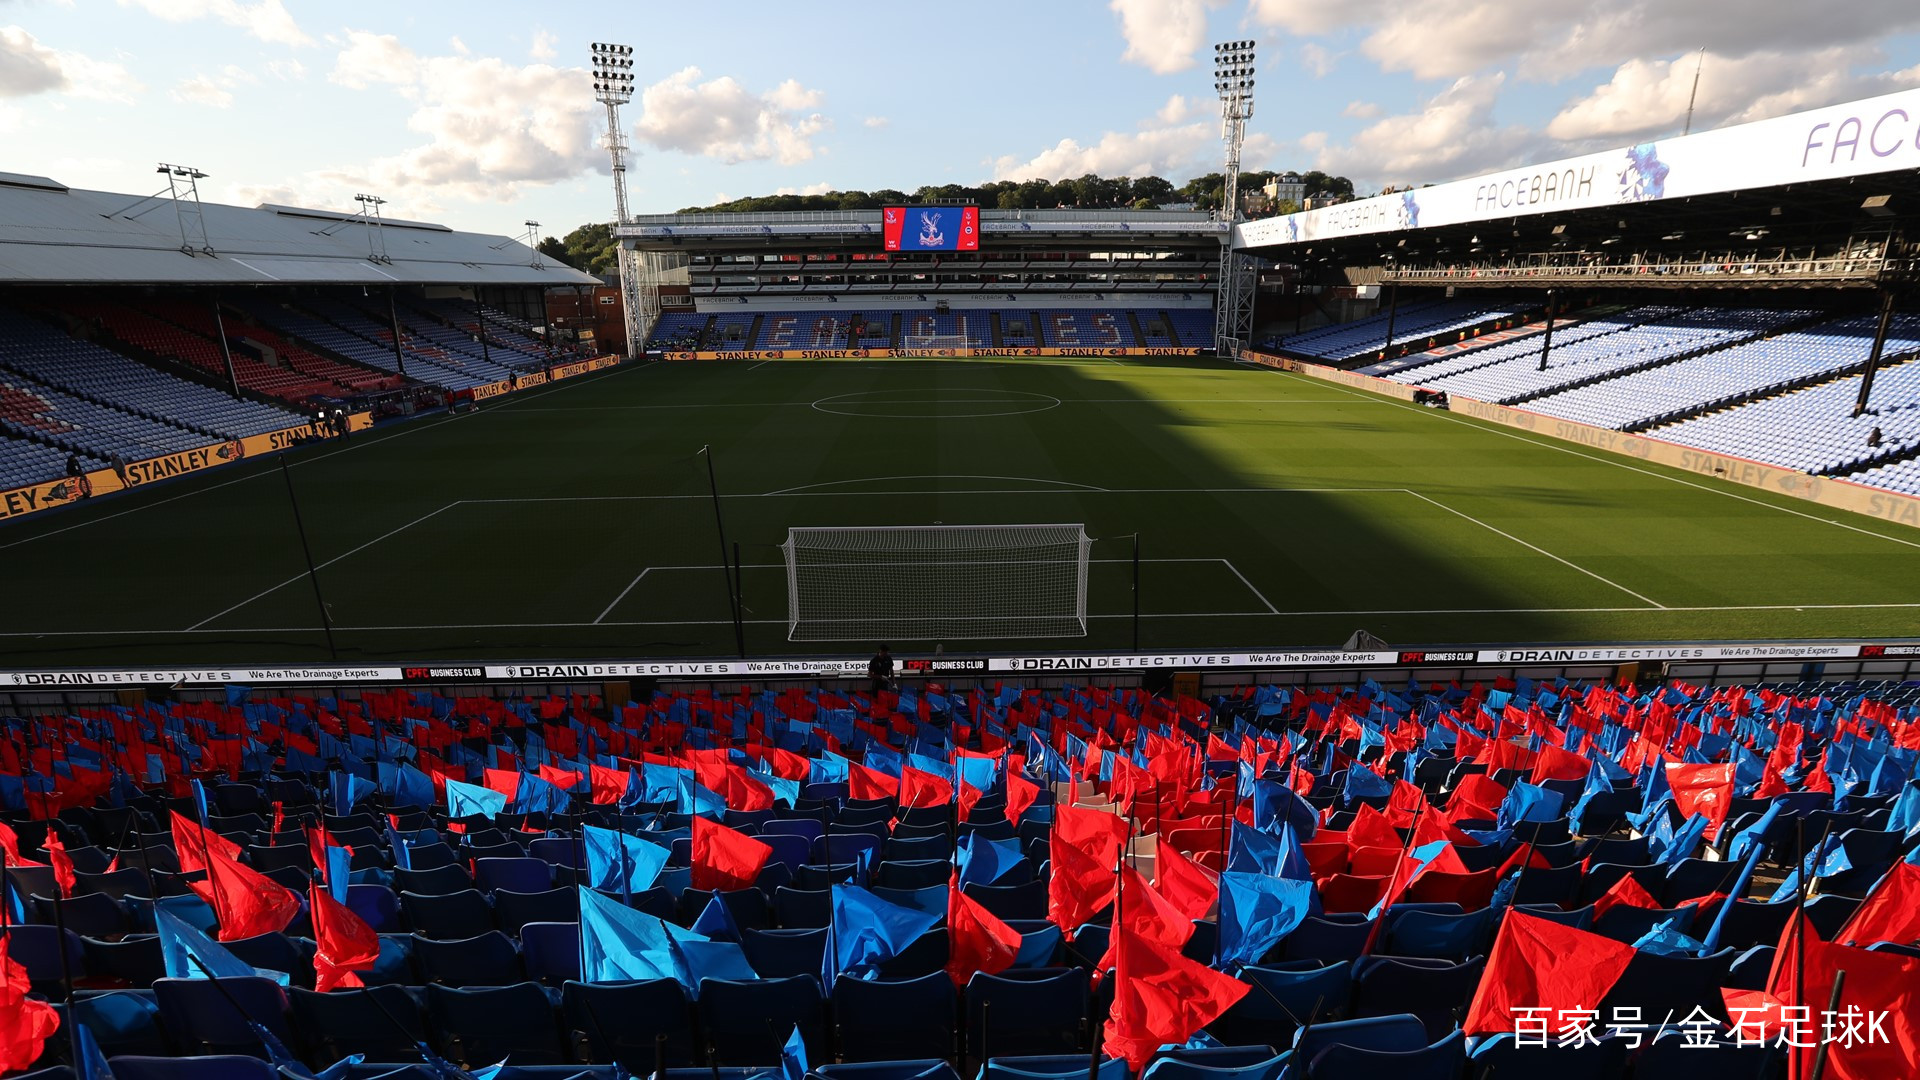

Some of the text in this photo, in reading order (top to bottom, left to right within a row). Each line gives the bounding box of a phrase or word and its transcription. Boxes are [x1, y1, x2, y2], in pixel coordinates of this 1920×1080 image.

[1802, 108, 1920, 168] FAC
[1475, 165, 1596, 212] FACEBANK
[715, 351, 762, 360] STANLEY
[801, 350, 848, 358] STANLEY
[887, 349, 934, 358] STANLEY
[973, 349, 1020, 357] STANLEY
[1059, 348, 1106, 356] STANLEY
[1144, 348, 1190, 356] STANLEY
[521, 372, 546, 388] STANLEY
[474, 383, 501, 400] TANLEY
[1466, 403, 1512, 425] STANLEY
[1556, 422, 1618, 448] STANLEY
[127, 449, 211, 485] STANLEY
[1680, 451, 1772, 488] STANLEY
[1402, 653, 1474, 662] CPFC BUSINESS CLUB
[1510, 649, 1703, 661] DRAIN DETECTIVES
[1720, 647, 1839, 657] We Are The Drainage Experts
[1023, 656, 1230, 669] DRAIN DETECTIVES
[1249, 653, 1376, 664] We Are The Drainage Experts
[519, 664, 729, 677] DRAIN DETECTIVES
[747, 661, 869, 672] We Are The Drainage Exper
[908, 660, 984, 670] CPFC BUSINESS CLUB
[26, 672, 232, 685] DRAIN DETECTIVES
[249, 668, 379, 681] We Are The Drainage Experts
[406, 668, 482, 679] CPFC BUSINESS CLUB
